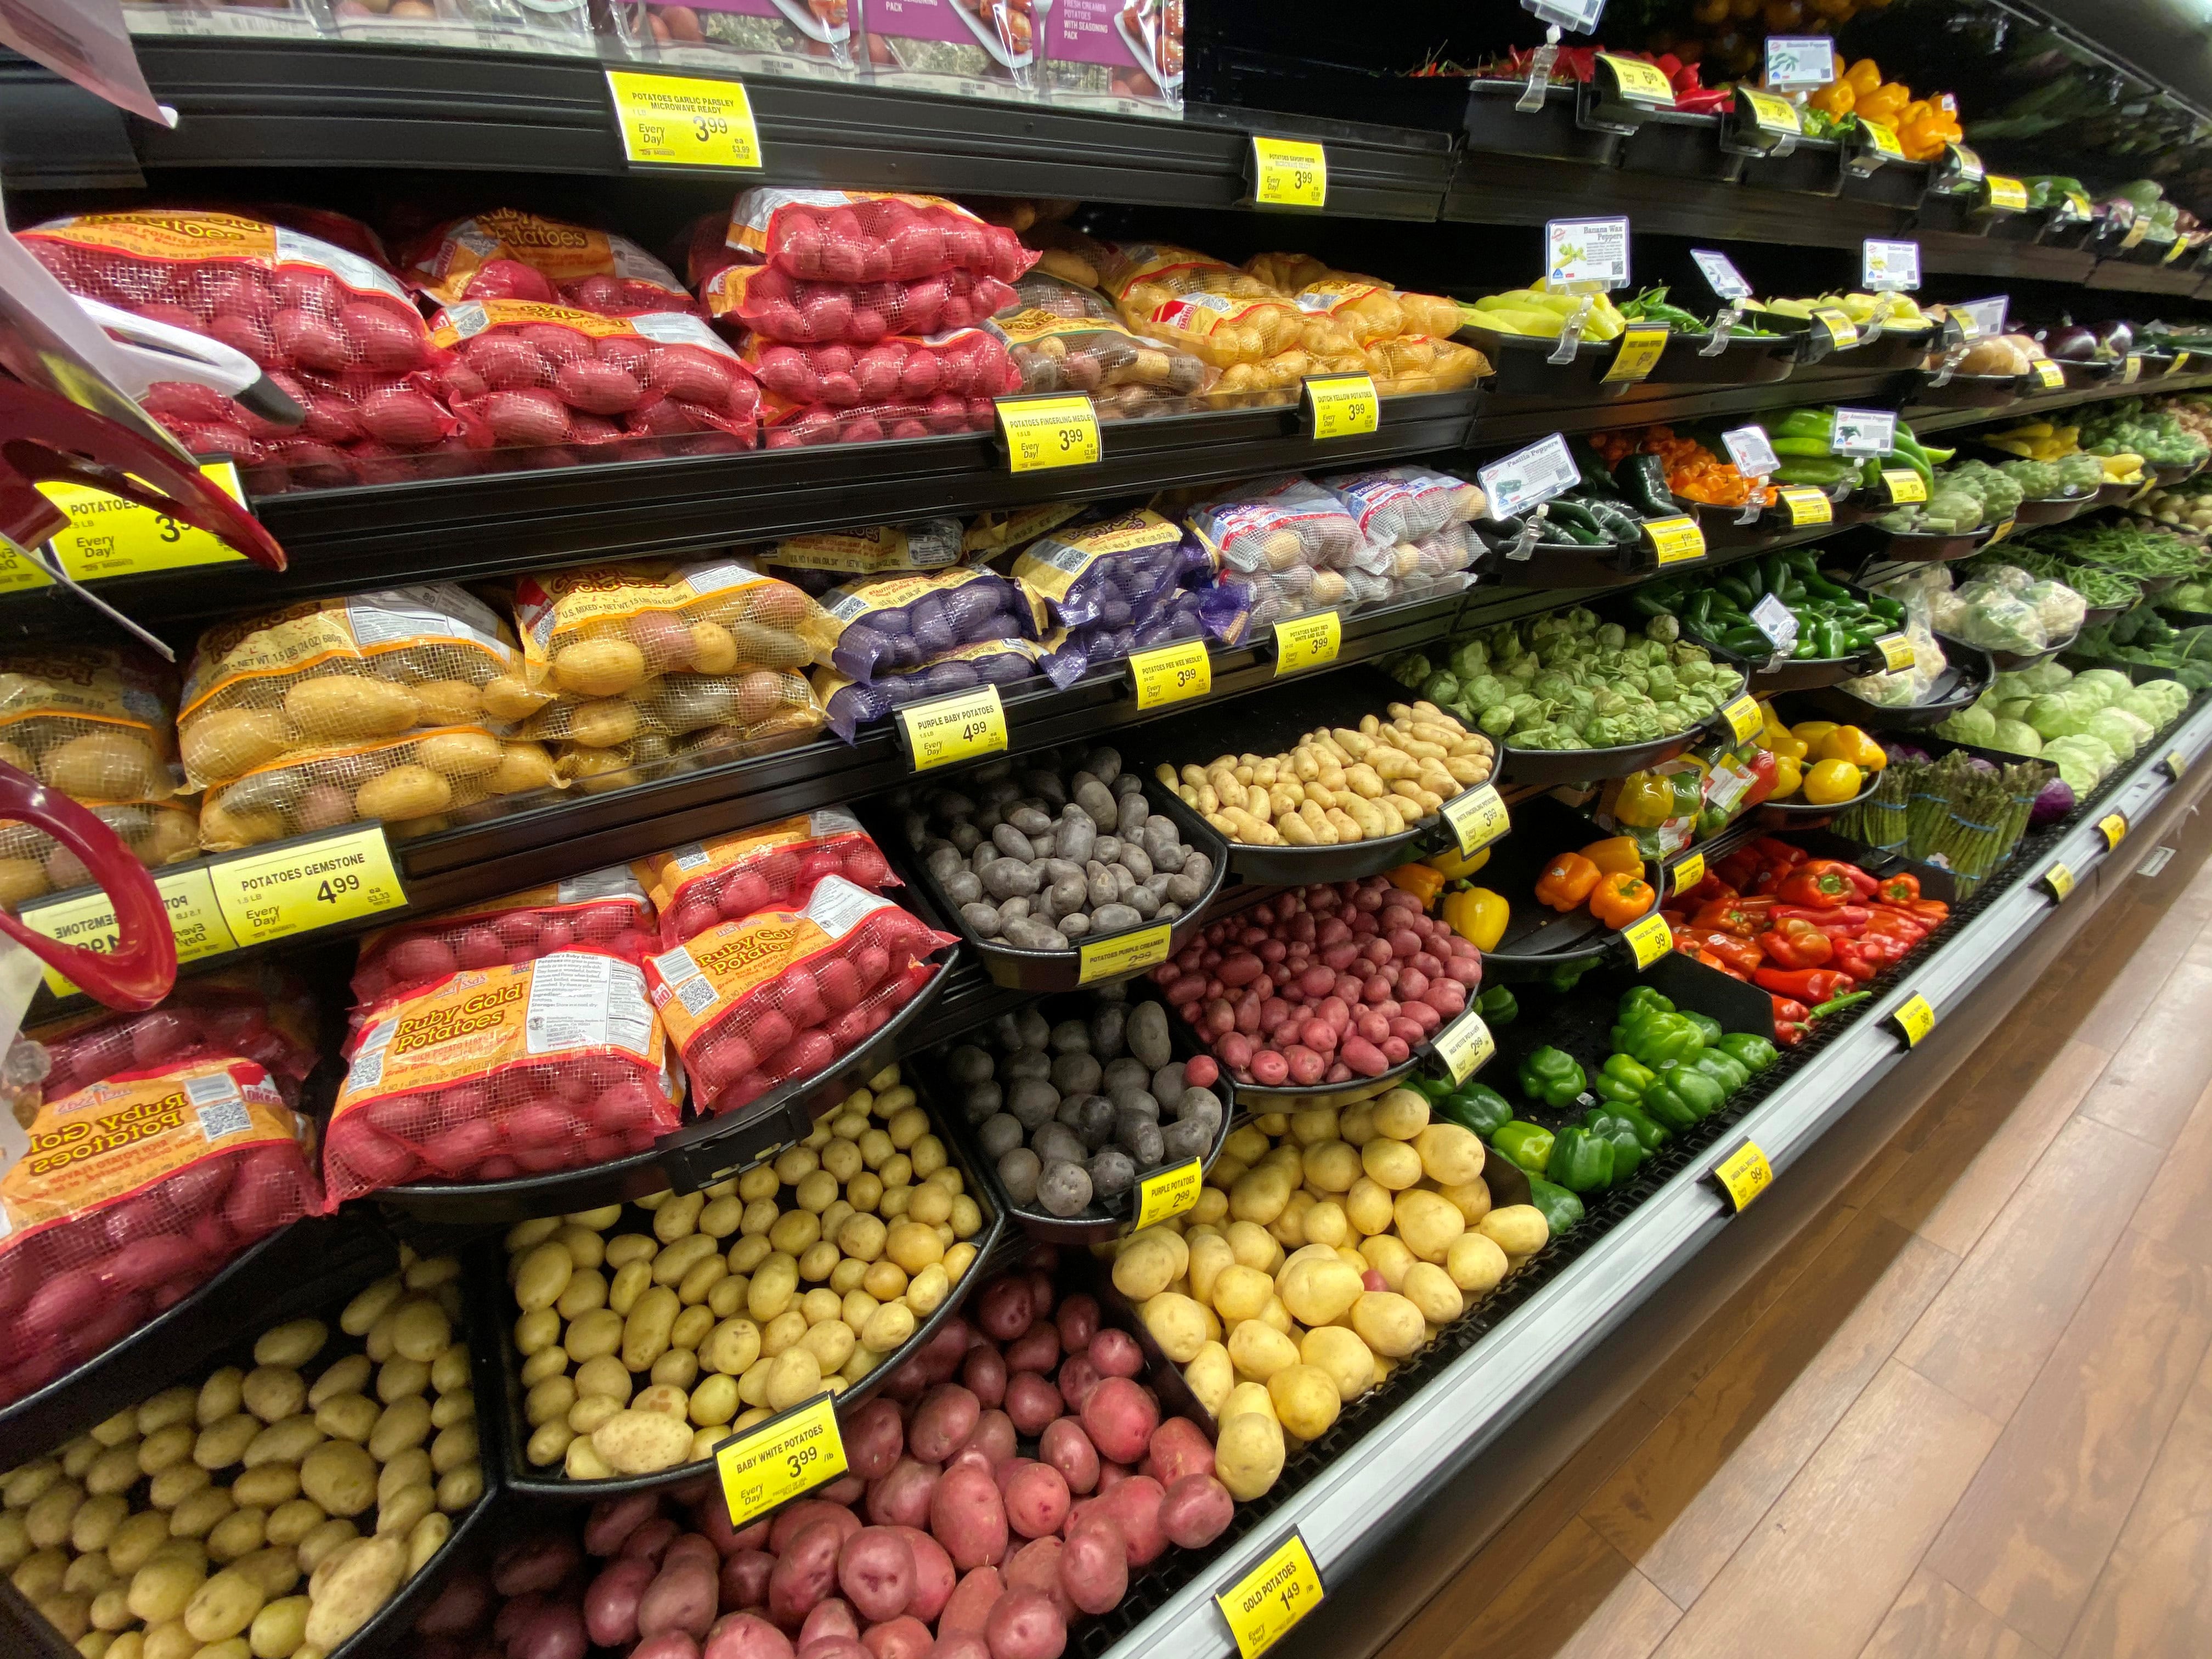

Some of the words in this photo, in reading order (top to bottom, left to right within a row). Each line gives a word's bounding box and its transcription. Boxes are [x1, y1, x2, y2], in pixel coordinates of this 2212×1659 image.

[1064, 10, 1091, 20] POTATOES
[1064, 20, 1077, 30] WITH
[1079, 22, 1108, 33] SEASONING
[1064, 30, 1078, 40] PACK
[631, 92, 673, 103] POTATOES
[674, 95, 700, 105] GARLIC
[702, 98, 734, 108] PARSLEY
[651, 102, 696, 113] MICROWAVE
[698, 105, 721, 114] READY
[639, 123, 665, 136] Every
[643, 133, 665, 145] Day!
[1598, 233, 1623, 242] Peppers
[1179, 307, 1194, 330] DAHO
[1333, 393, 1350, 402] YELLOW
[1351, 391, 1372, 399] POTATOES
[1010, 418, 1040, 428] POTATOES
[1040, 416, 1072, 426] FINGERLING
[1073, 414, 1094, 422] MEDLEY
[1021, 443, 1039, 452] Every
[1024, 449, 1039, 459] Day!
[1531, 440, 1559, 457] Peppers
[76, 535, 115, 549] Every
[84, 544, 115, 558] Day!
[562, 609, 576, 619] U.S.
[576, 605, 598, 615] MIXED
[1290, 629, 1310, 637] POTATOES
[237, 658, 255, 667] NET
[273, 652, 284, 662] 1.5
[284, 645, 298, 658] LBS
[322, 634, 342, 646] 680g
[1142, 665, 1166, 674] POTATOES
[1185, 655, 1203, 664] MEDLEY
[918, 716, 943, 730] PURPLE
[944, 712, 961, 724] BABY
[962, 705, 994, 720] POTATOES
[924, 740, 943, 749] Every
[927, 747, 942, 756] Day!
[241, 868, 302, 891] POTATOES
[304, 853, 365, 876] GEMSTONE
[251, 894, 262, 902] LB
[246, 906, 280, 919] Every
[253, 913, 280, 927] Day!
[697, 934, 754, 967] Ruby
[1090, 951, 1118, 963] POTATOES
[1119, 946, 1138, 956] PURPLE
[1139, 939, 1164, 950] CREAMER
[712, 941, 793, 976] Potatoe
[753, 955, 778, 969] POTATO
[397, 1006, 461, 1036] Ruby
[464, 983, 523, 1012] Gold
[395, 1008, 505, 1055] Potatoes
[1152, 1183, 1170, 1198] PURPLE
[1171, 1175, 1195, 1190] POTATOES
[737, 1455, 757, 1474] BABY
[758, 1444, 783, 1463] WHITE
[785, 1424, 823, 1451] POTATOES
[741, 1483, 764, 1499] Every
[745, 1491, 763, 1505] Day!
[1243, 1590, 1262, 1613] GOLD
[1262, 1561, 1297, 1598] POTATOES
